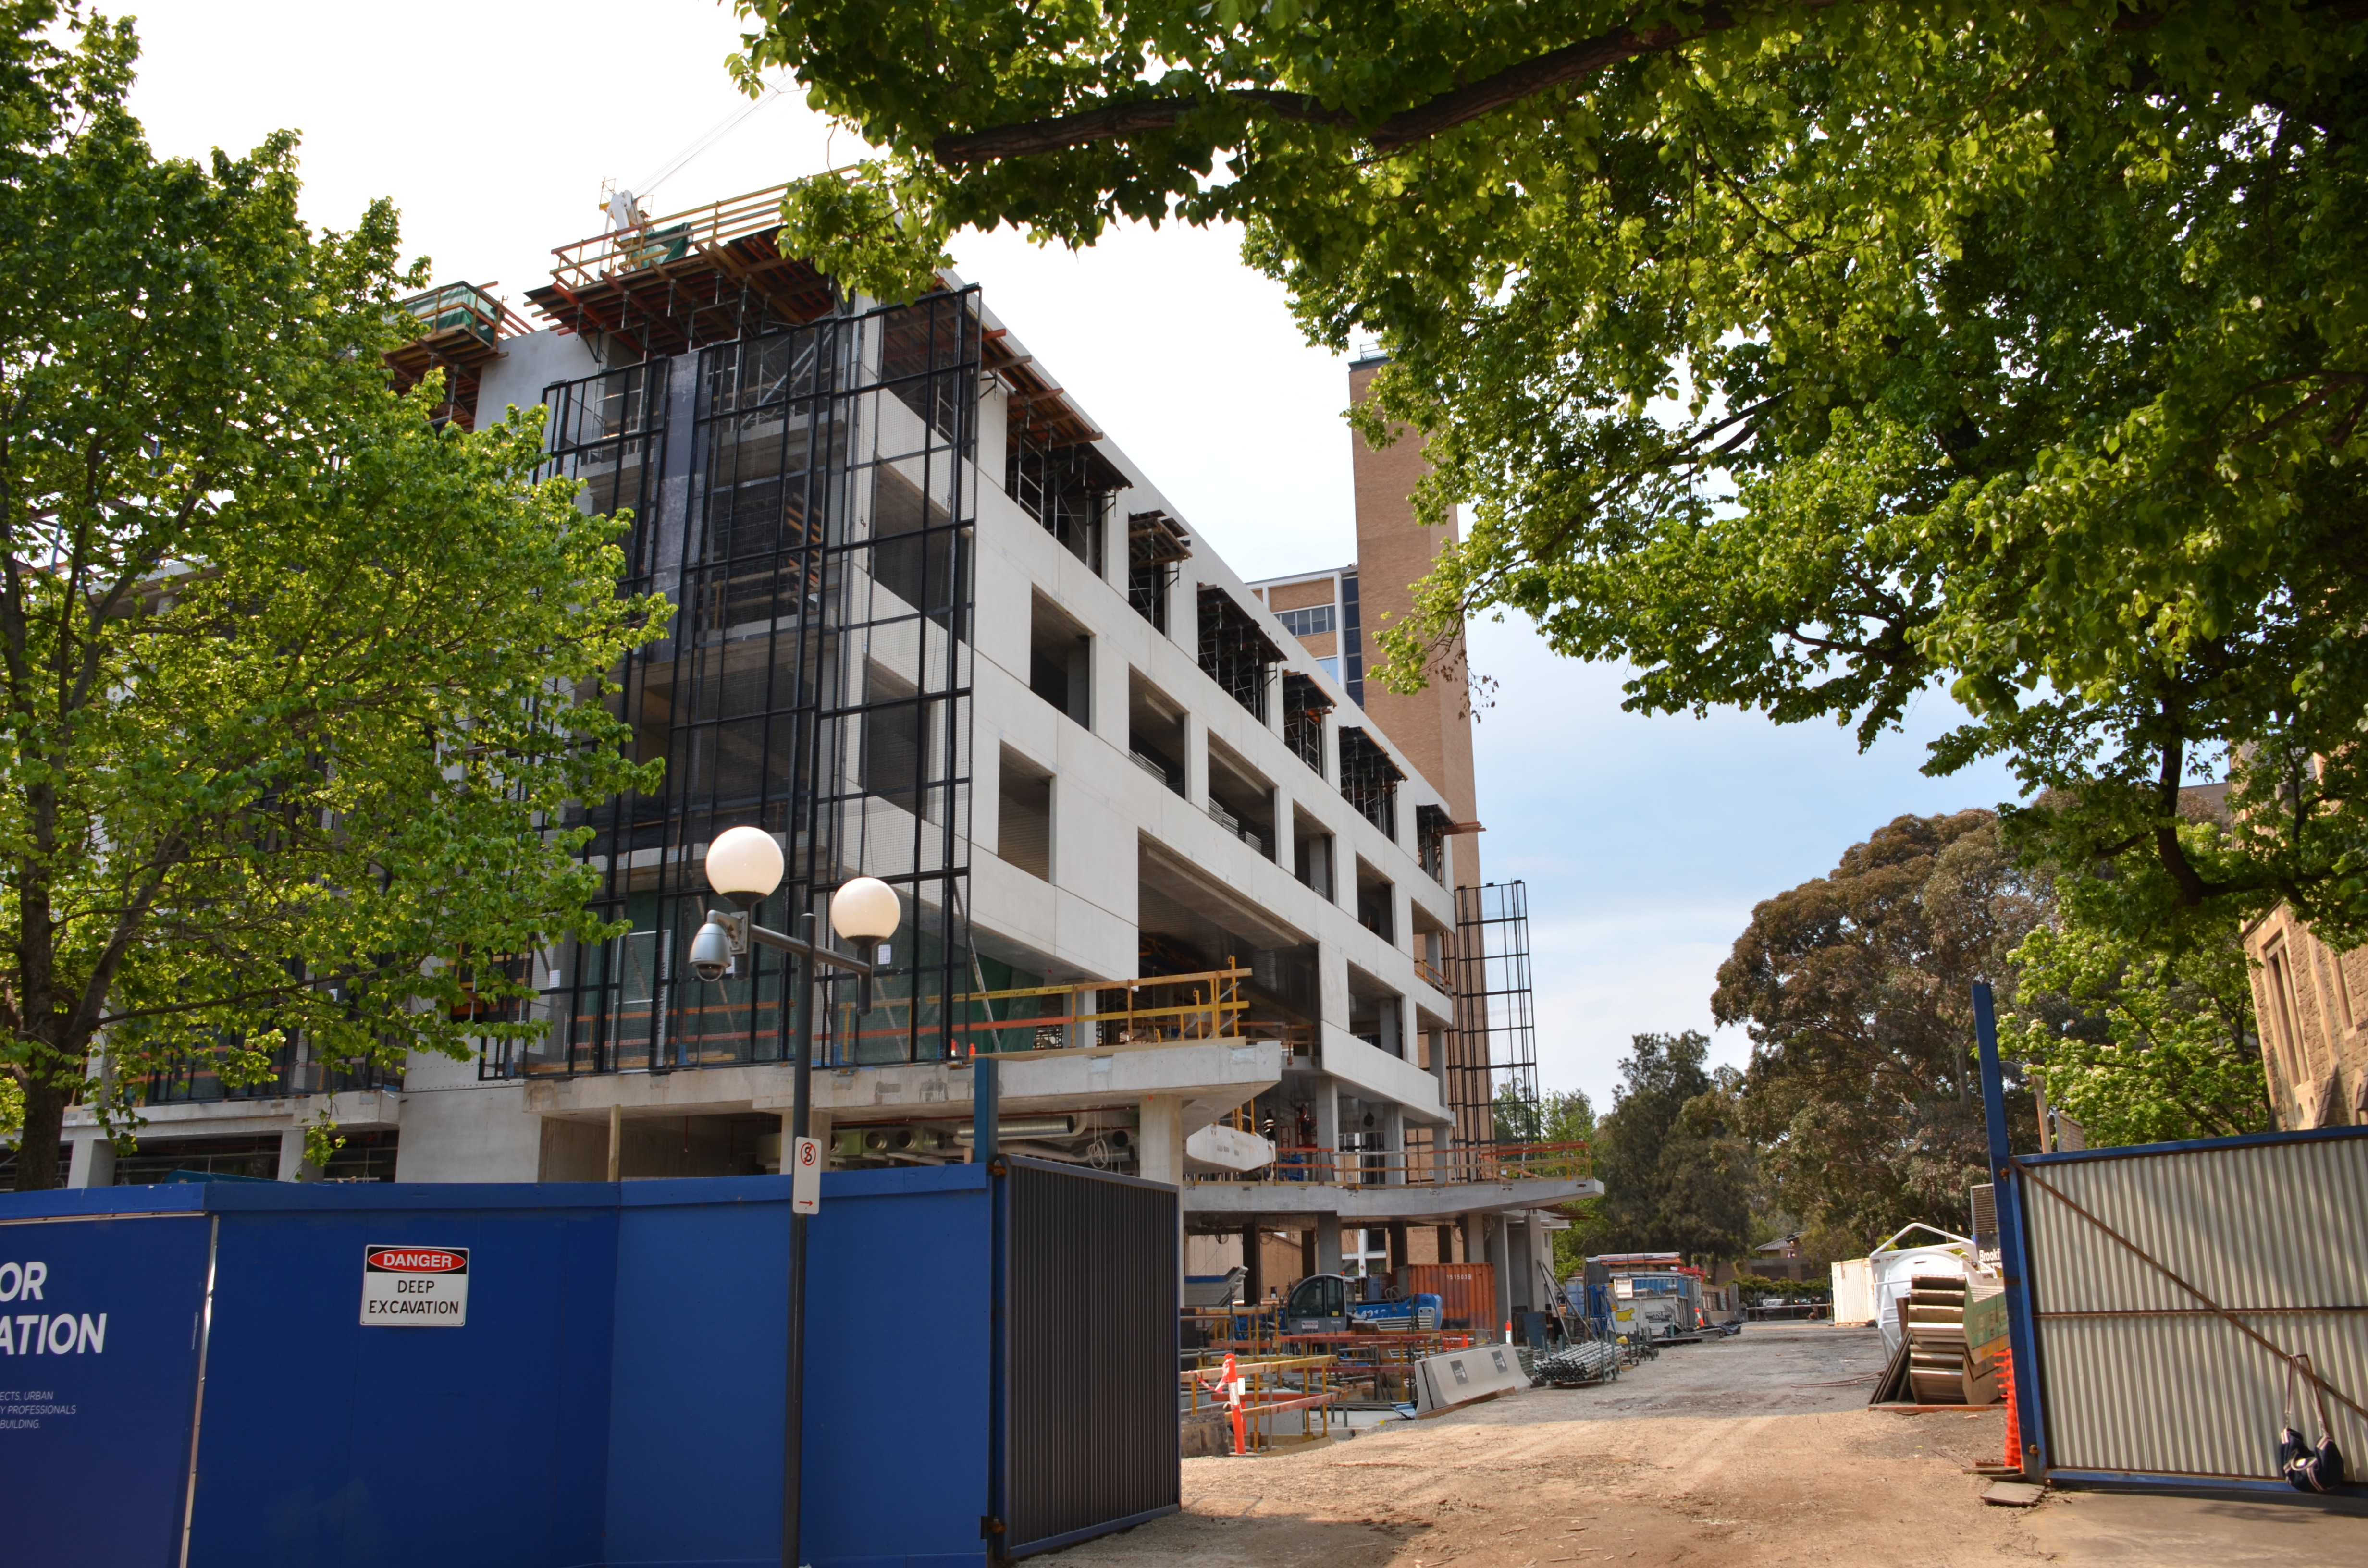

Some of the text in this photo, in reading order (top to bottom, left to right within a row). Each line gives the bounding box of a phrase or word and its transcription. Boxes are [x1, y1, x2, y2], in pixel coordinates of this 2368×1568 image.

[383, 1253, 452, 1268] DANGER
[397, 1280, 435, 1293] DEEP
[369, 1300, 459, 1314] EXCAVATION
[24, 1391, 54, 1401] URBAN
[7, 1405, 76, 1415] PROFESSIONALS
[0, 1419, 40, 1429] BUILDING.
